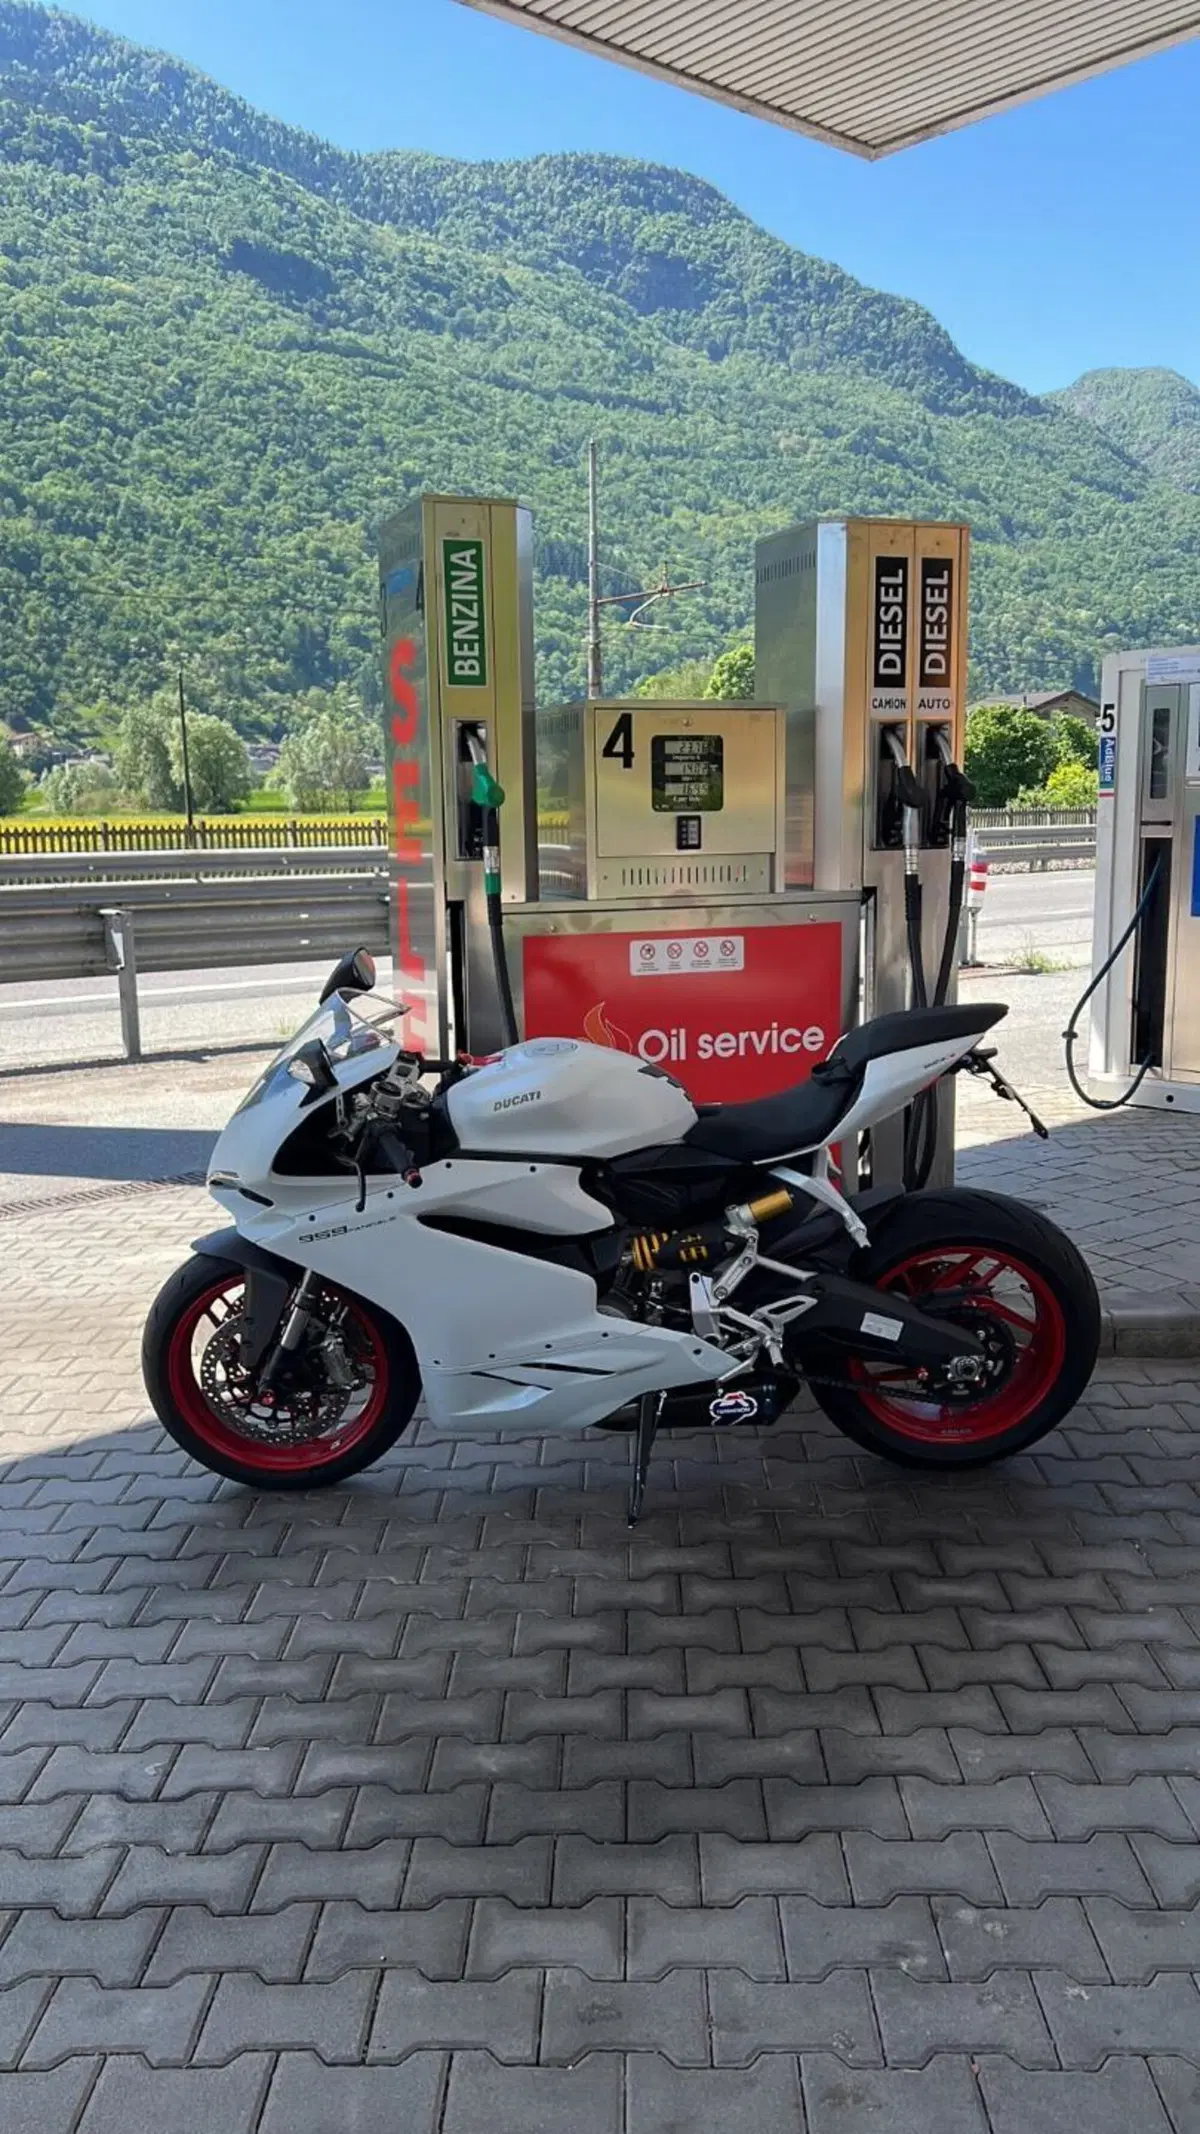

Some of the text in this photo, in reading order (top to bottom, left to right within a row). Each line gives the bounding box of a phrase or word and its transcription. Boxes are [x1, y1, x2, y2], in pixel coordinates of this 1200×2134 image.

[450, 548, 480, 677] BENZINA
[878, 568, 904, 675] DIESEL
[924, 570, 949, 675] DIESEL
[872, 697, 907, 710] CAMION
[918, 697, 951, 710] AUTO
[1101, 703, 1115, 733] 5
[602, 712, 635, 769] 4
[1104, 739, 1115, 781] AdBlue
[638, 1022, 825, 1063] Oil service
[493, 1090, 541, 1112] DUCATI
[299, 1225, 347, 1243] 959
